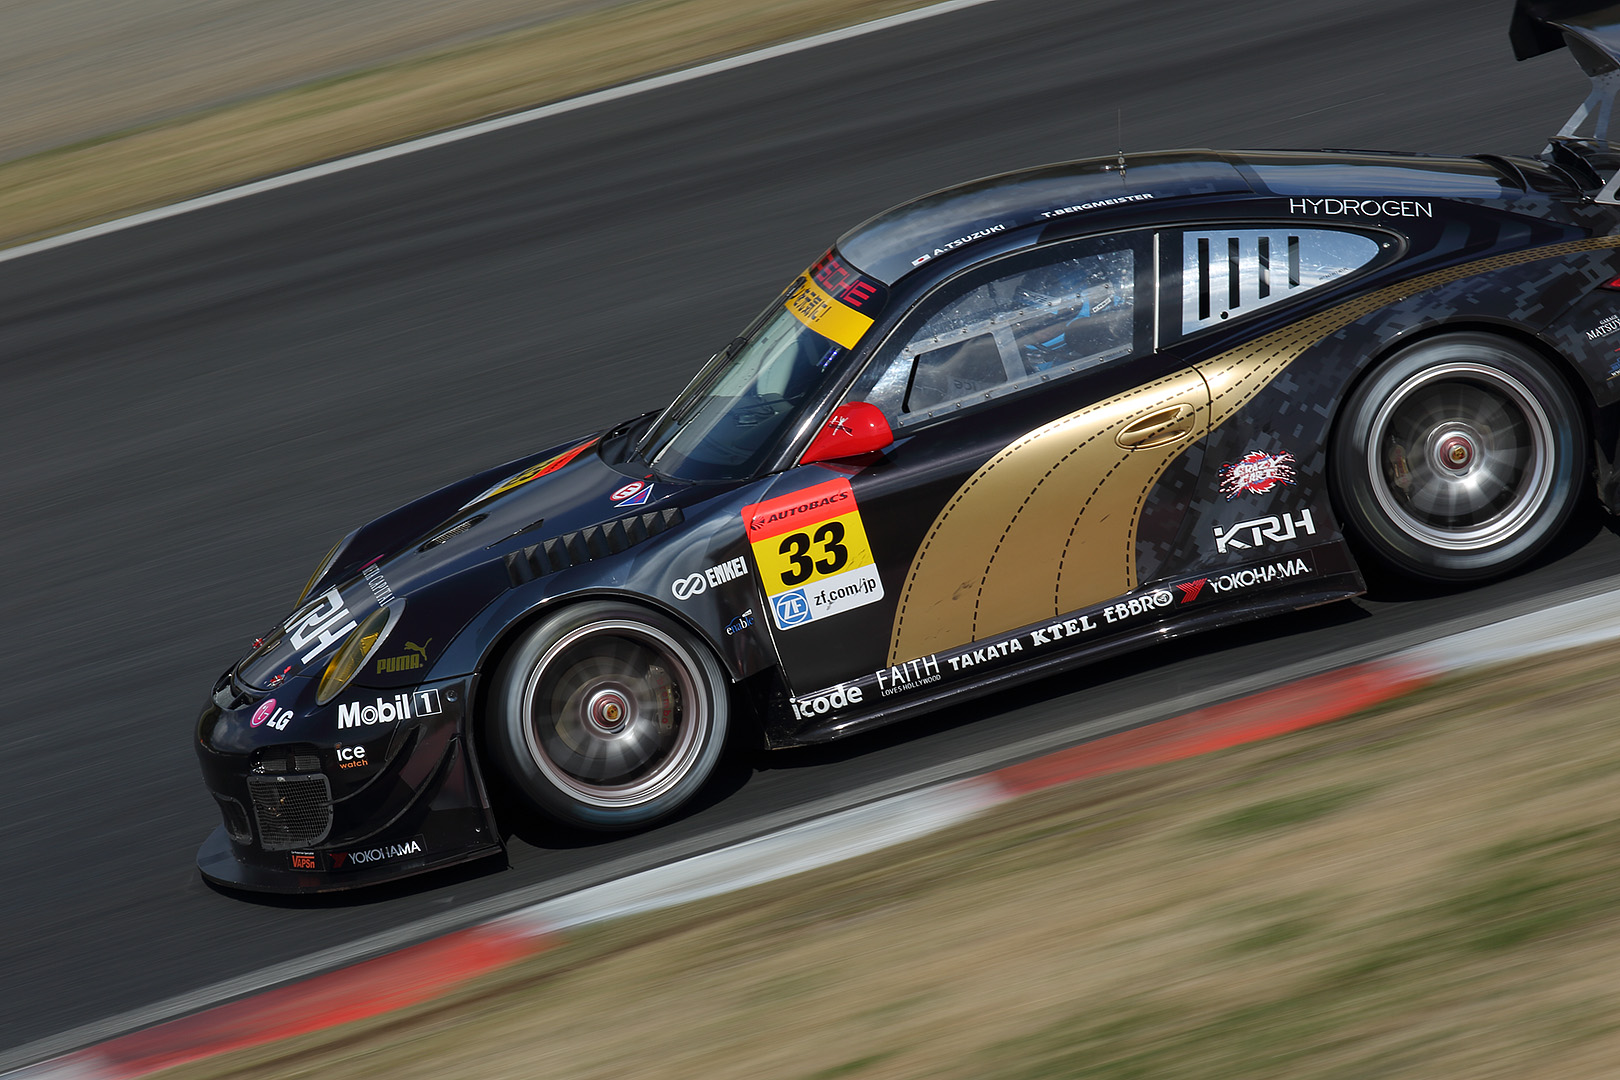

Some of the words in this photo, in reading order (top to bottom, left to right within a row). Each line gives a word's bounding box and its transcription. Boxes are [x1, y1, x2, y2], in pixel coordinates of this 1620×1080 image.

[1041, 192, 1154, 219] T.BERGMEISTER
[1289, 198, 1433, 218] HYDROGEN
[932, 223, 1006, 257] A.TSUZUKI
[767, 491, 849, 524] AUTOBACS
[1214, 508, 1317, 553] KRH
[778, 521, 849, 587] 33
[706, 556, 749, 588] ENKEI
[1207, 558, 1310, 594] YOKOHAMA
[780, 600, 802, 621] ZF
[813, 576, 877, 606] zf.com/jp
[1103, 590, 1174, 624] EBBRO
[1030, 616, 1097, 647] KTEL
[376, 653, 420, 674] PUMA
[947, 638, 1023, 671] TAKATA
[875, 653, 940, 690] FAITH
[881, 686, 903, 697] LOVES
[902, 674, 942, 691] HOLLYWOOD
[266, 707, 294, 731] LG
[337, 693, 411, 729] Mobil
[420, 692, 432, 713] 1
[789, 685, 864, 720] icode
[336, 742, 366, 761] ice
[339, 759, 369, 769] watch
[348, 840, 422, 865] YOKOHAMA
